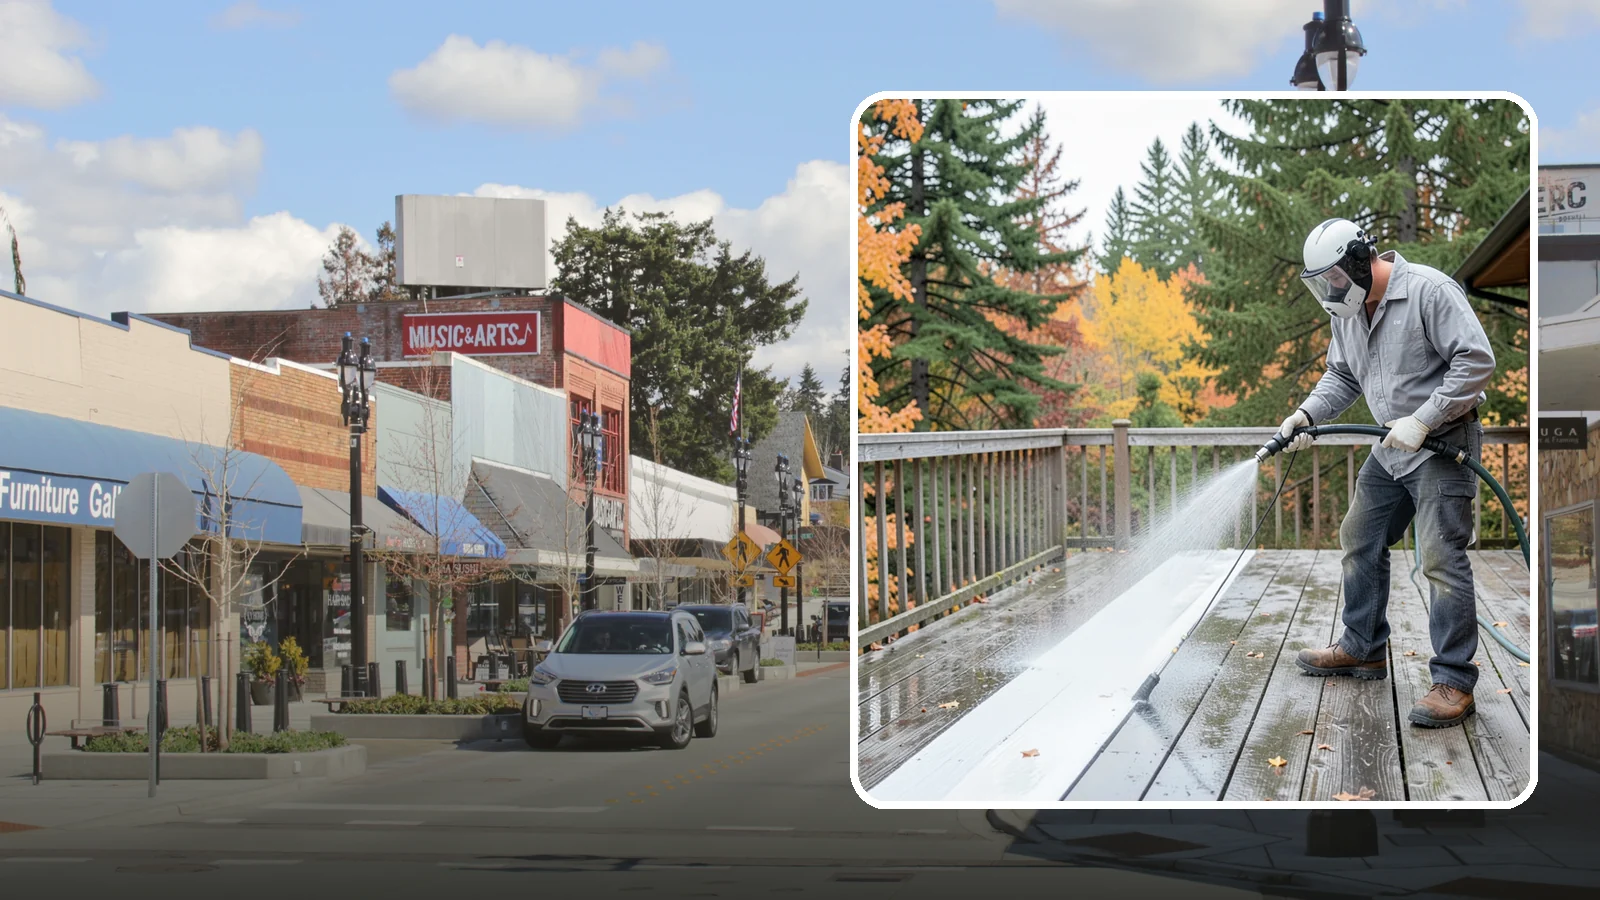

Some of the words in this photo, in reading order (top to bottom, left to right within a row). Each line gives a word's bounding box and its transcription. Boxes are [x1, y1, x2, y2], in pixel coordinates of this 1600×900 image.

[409, 323, 519, 349] MUSIC&ARTS
[0, 471, 80, 516] Furniture
[89, 482, 122, 519] Gal
[453, 563, 479, 574] SUSHI
